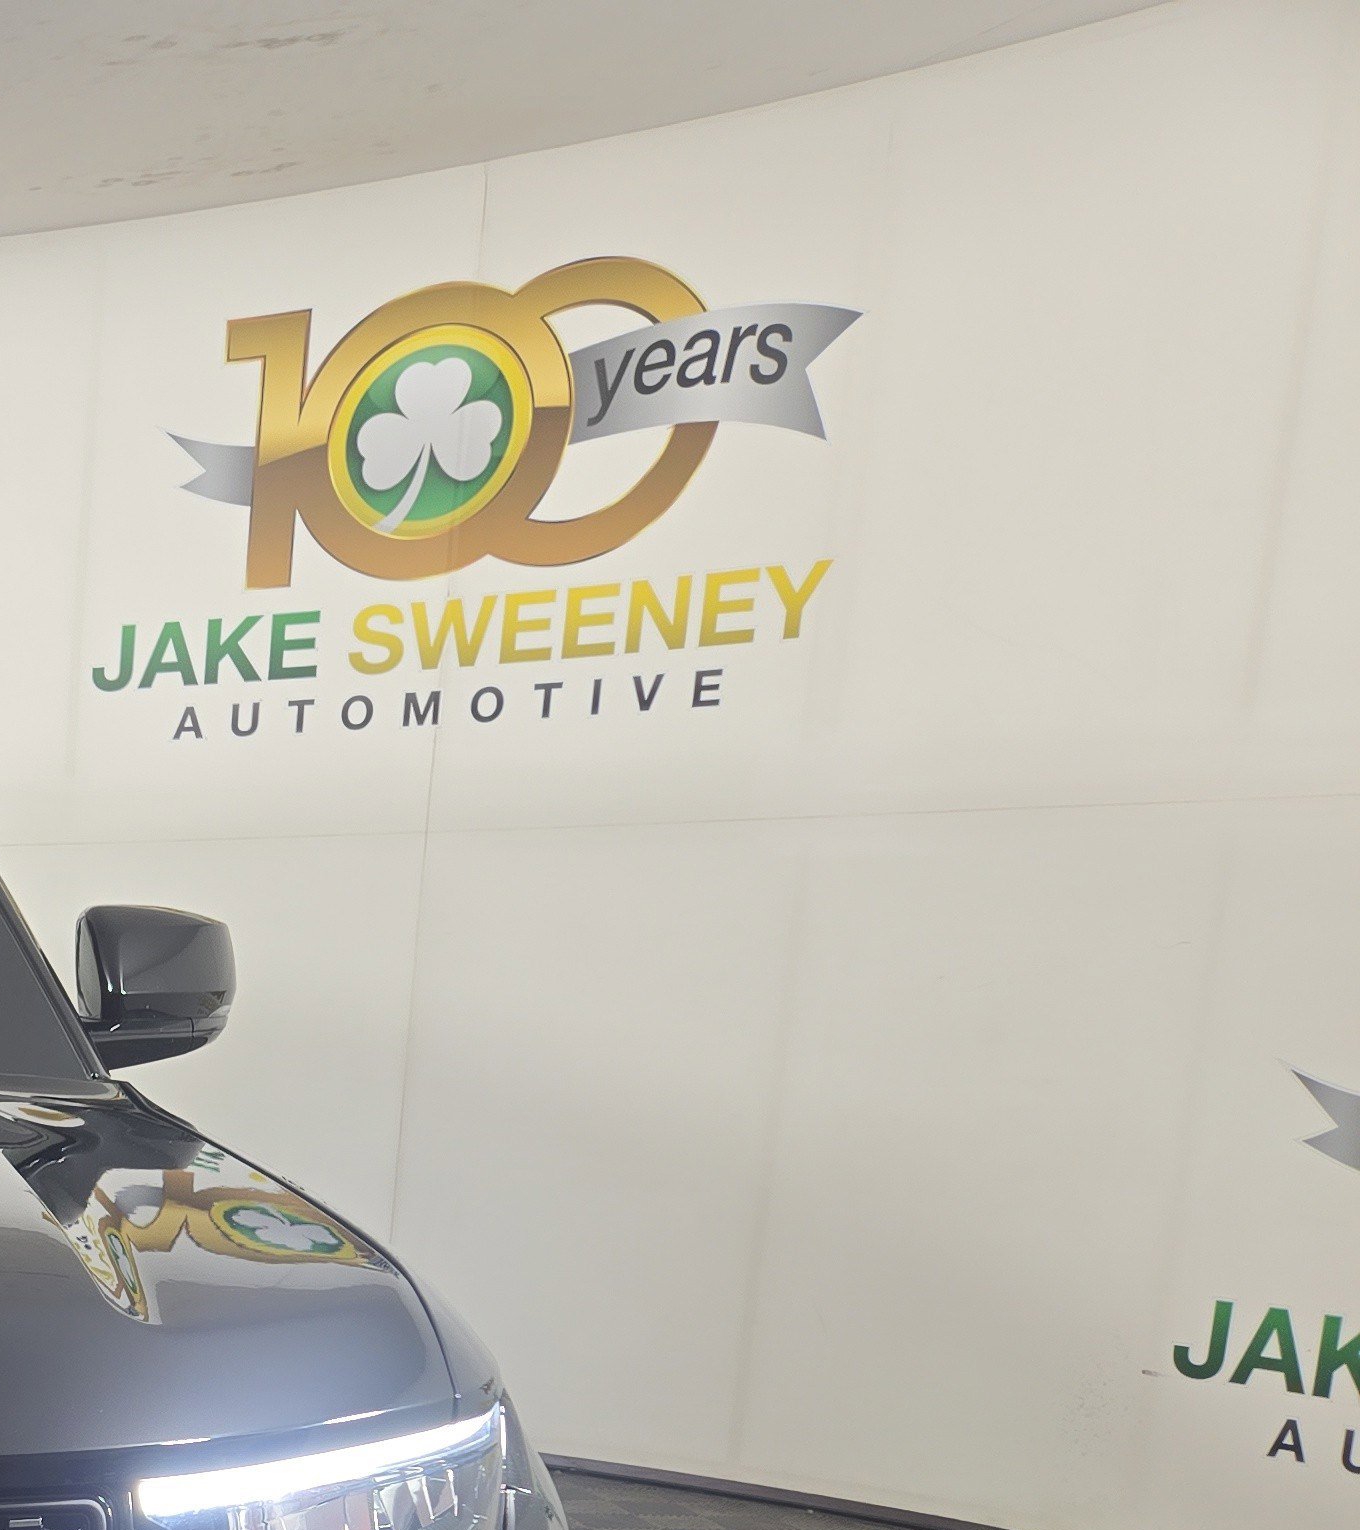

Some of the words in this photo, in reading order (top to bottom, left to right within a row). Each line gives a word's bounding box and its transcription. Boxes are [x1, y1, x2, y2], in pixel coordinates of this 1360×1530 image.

[586, 322, 794, 427] years
[91, 610, 321, 692] JAKE
[348, 559, 834, 675] SWEENEY
[172, 668, 725, 741] AUTOMOTIVE
